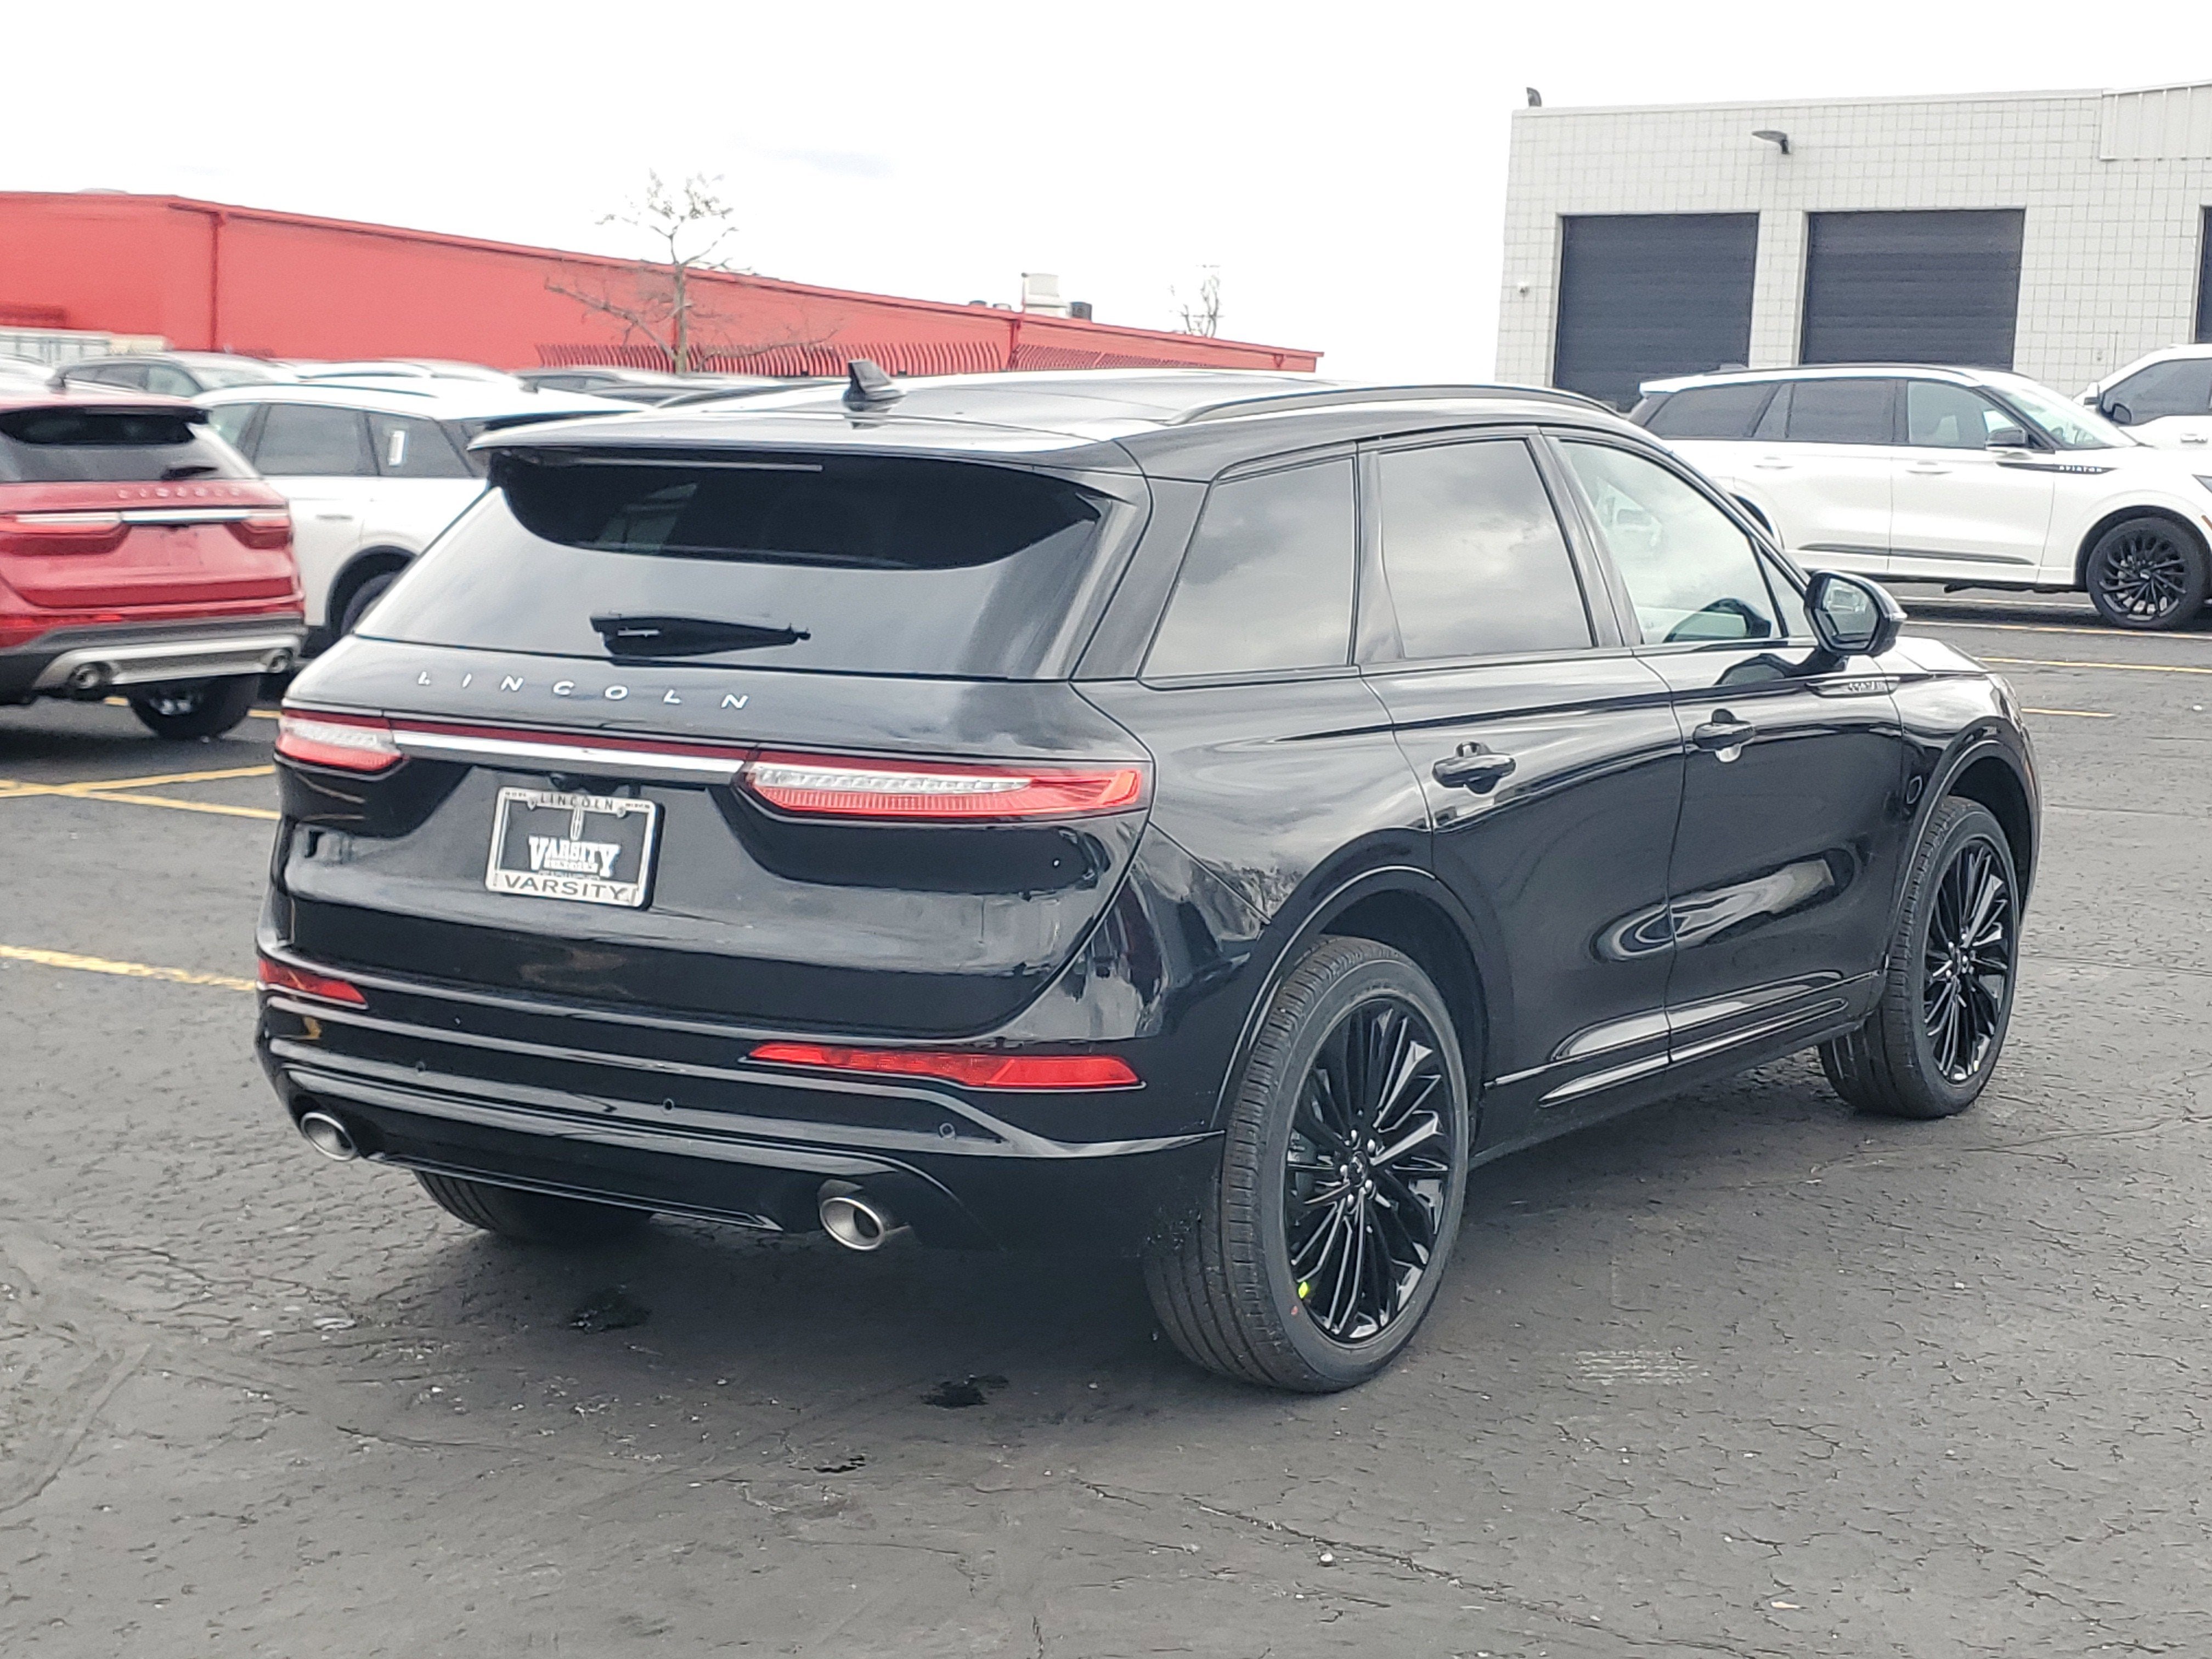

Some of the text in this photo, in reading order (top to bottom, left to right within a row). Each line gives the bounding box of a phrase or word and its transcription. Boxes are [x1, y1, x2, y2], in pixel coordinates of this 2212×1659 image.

[418, 671, 749, 709] LINCOLN
[540, 793, 614, 811] LINCOLN
[528, 835, 621, 878] VARSITY
[504, 874, 628, 901] VARSITY
